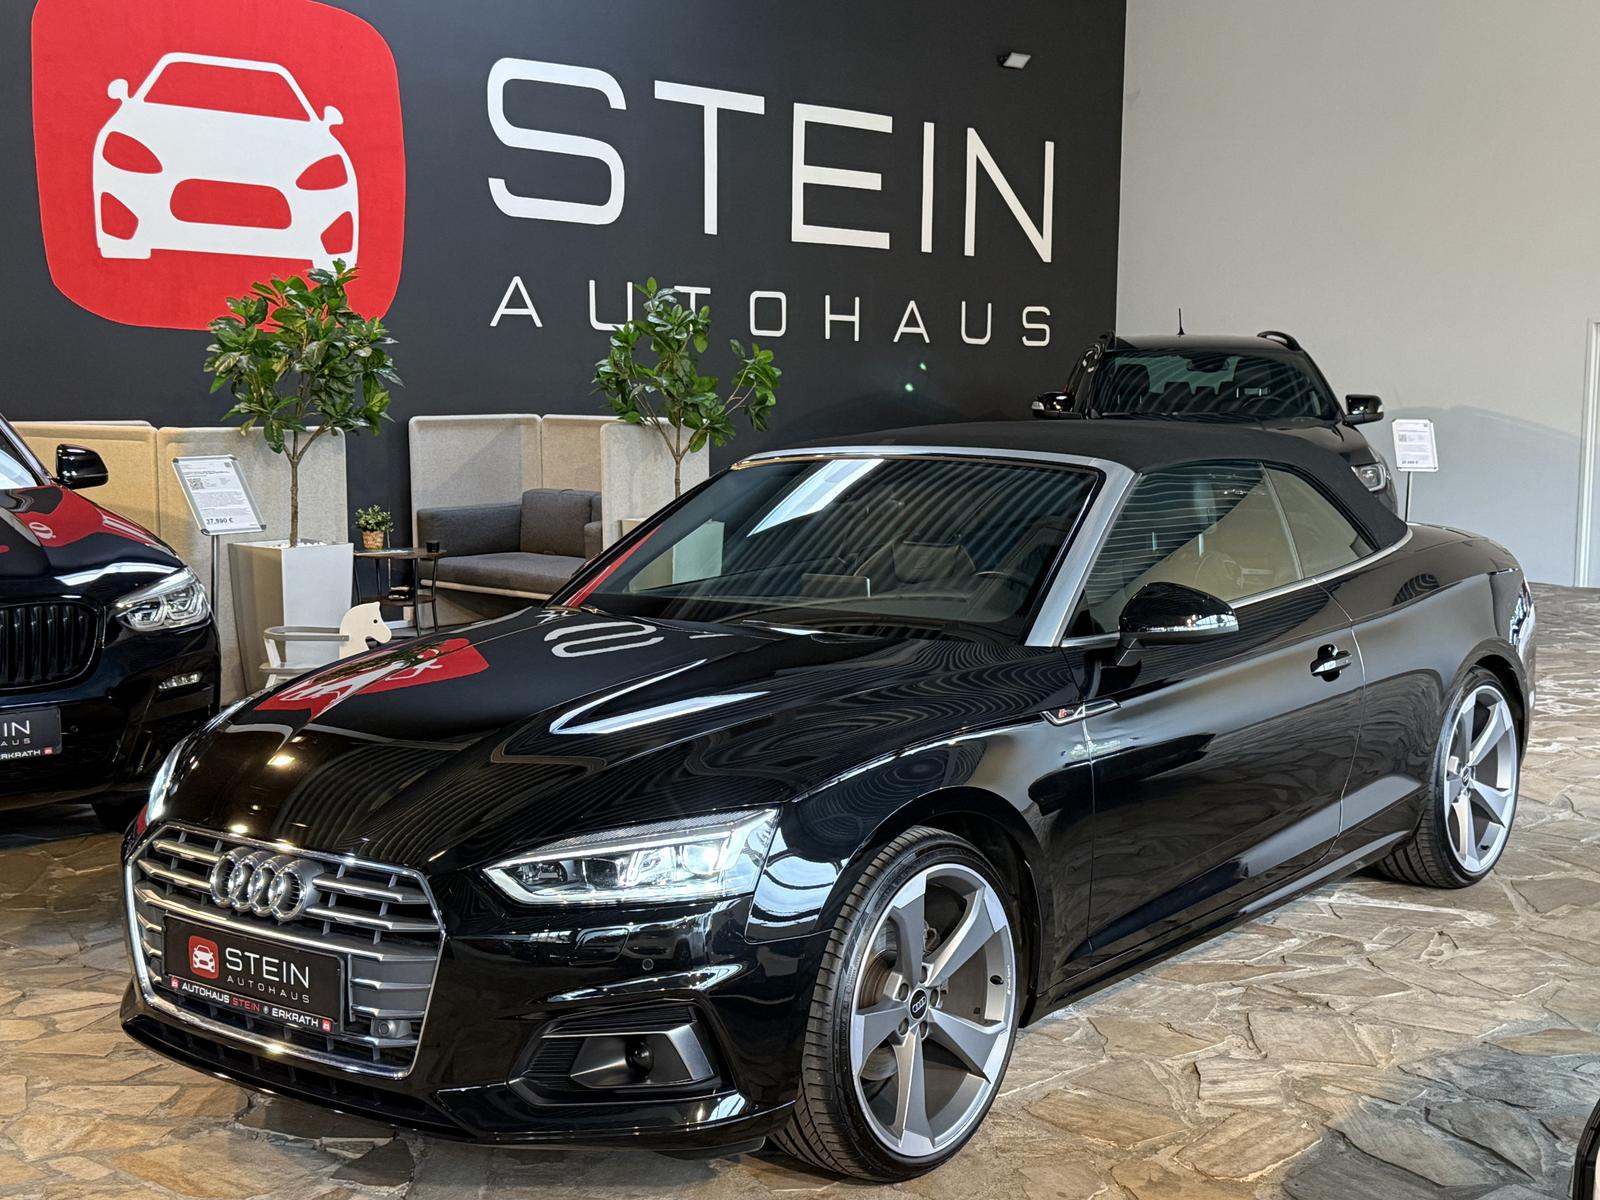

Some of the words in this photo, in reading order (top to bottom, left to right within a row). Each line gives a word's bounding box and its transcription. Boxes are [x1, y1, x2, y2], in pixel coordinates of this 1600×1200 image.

[487, 57, 1054, 263] STEIN
[489, 275, 1051, 347] AUTOHAUS
[0, 749, 41, 760] RKRATH
[225, 947, 310, 989] STEIN
[227, 975, 310, 1004] AUTOHAUS
[181, 982, 230, 1004] AUTOHAUS
[231, 997, 260, 1012] STEIN
[271, 1008, 319, 1028] ERKRATH
